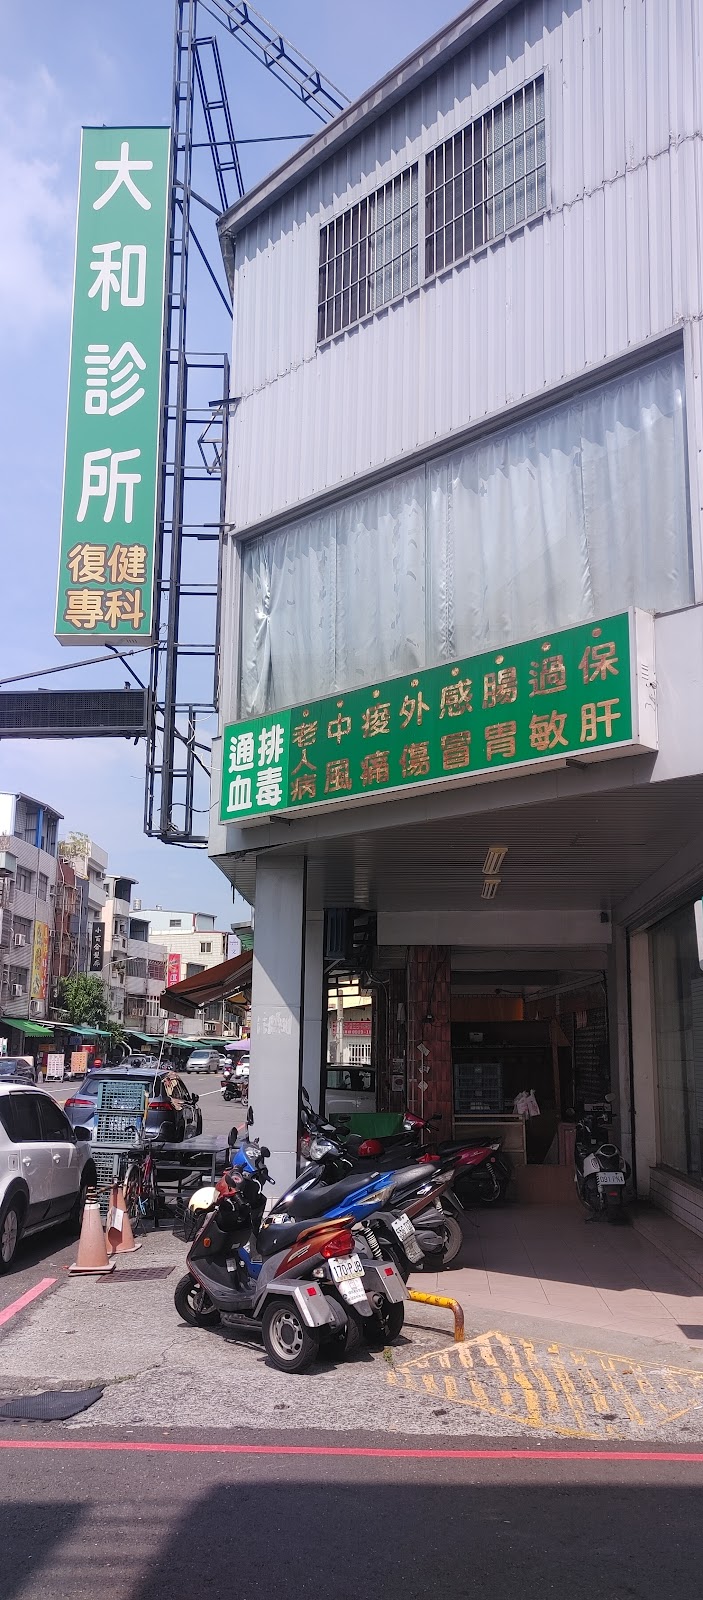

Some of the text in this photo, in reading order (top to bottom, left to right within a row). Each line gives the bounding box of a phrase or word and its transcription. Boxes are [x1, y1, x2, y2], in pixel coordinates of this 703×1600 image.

[76, 141, 154, 523] 大和診所
[67, 542, 148, 584] 復健
[64, 588, 145, 629] 專科
